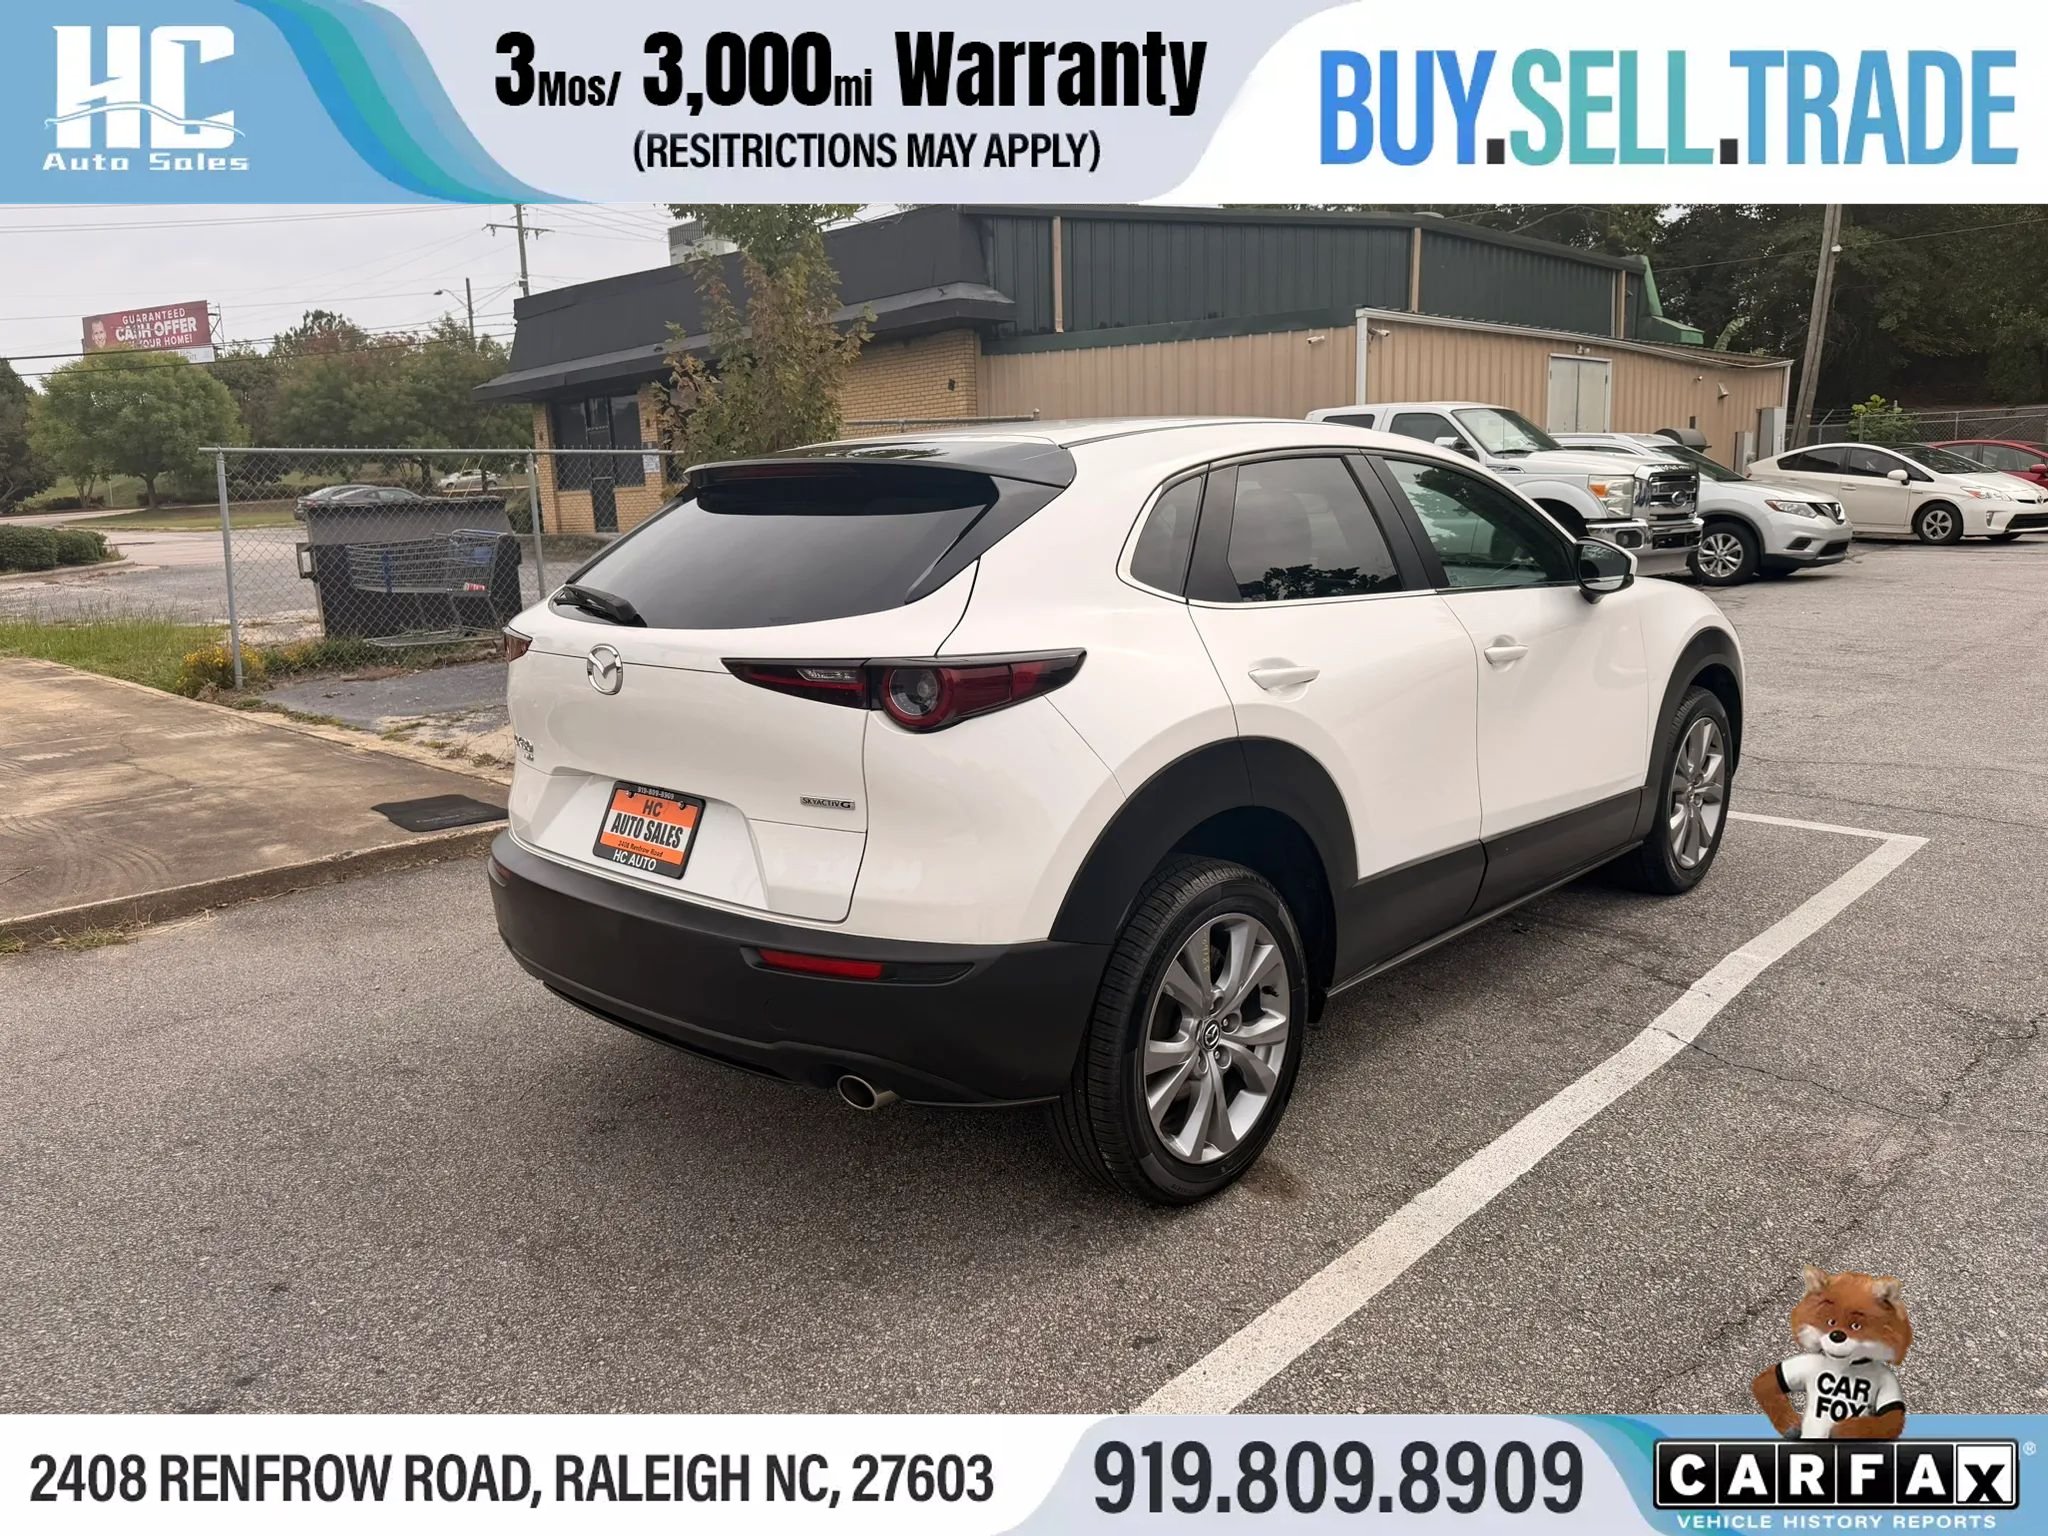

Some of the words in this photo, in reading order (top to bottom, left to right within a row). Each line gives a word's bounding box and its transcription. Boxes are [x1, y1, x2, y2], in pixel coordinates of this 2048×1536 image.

[122, 307, 186, 324] GUARANTEED
[154, 316, 198, 337] OFFER
[164, 334, 193, 346] HOME!
[642, 799, 663, 818] HC
[610, 812, 645, 839] AUTO
[644, 819, 684, 849] SALES
[612, 849, 629, 863] HC
[628, 854, 657, 871] AUTO
